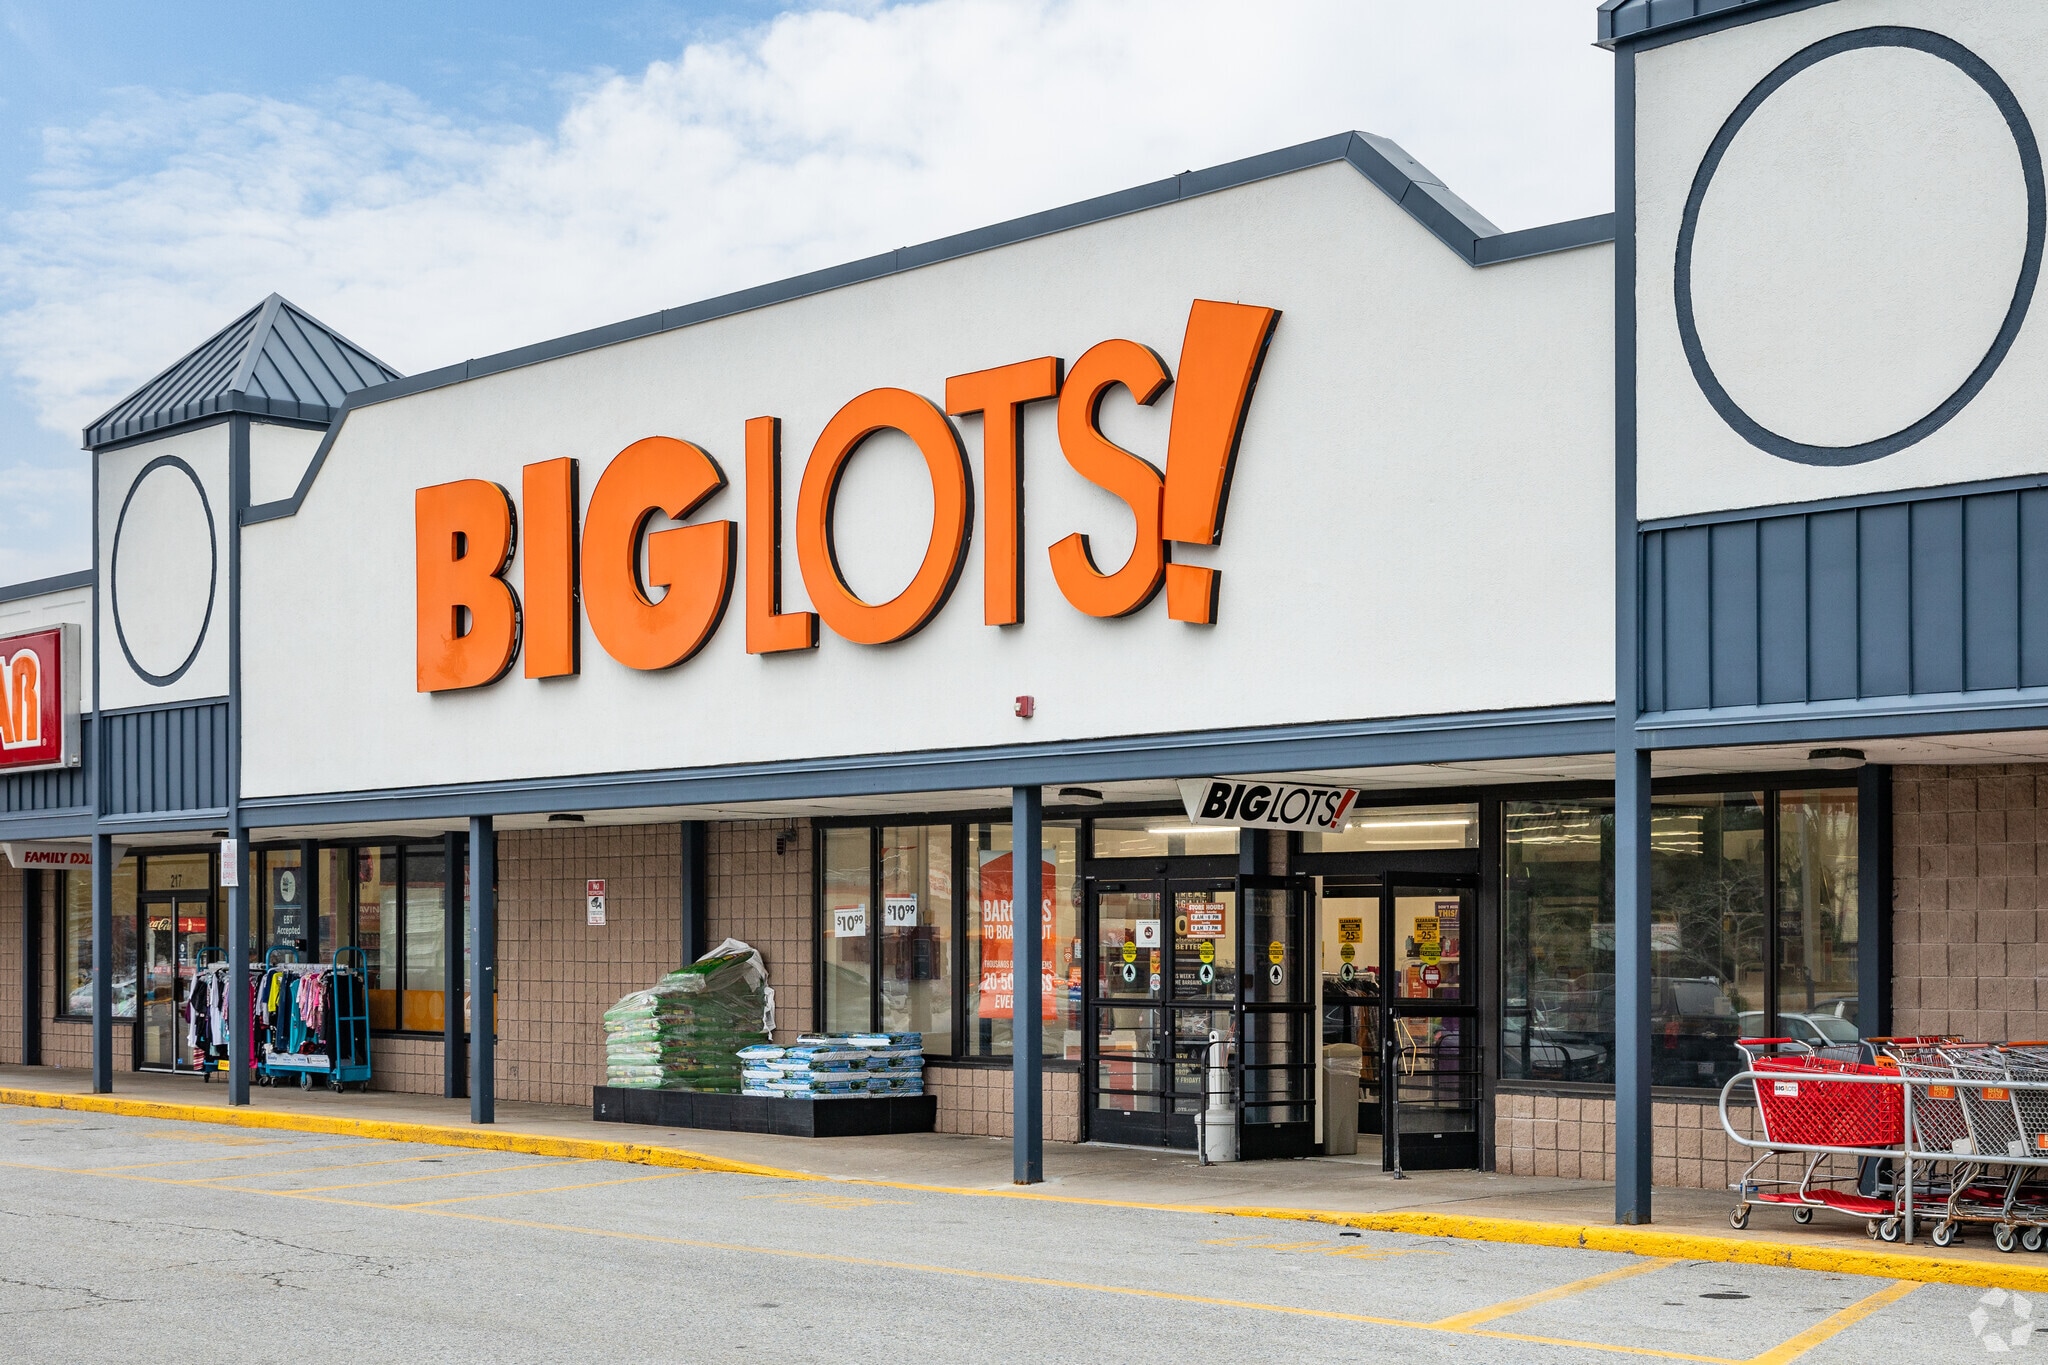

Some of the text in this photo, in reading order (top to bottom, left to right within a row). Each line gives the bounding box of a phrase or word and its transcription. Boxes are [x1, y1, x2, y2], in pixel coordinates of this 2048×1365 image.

[24, 851, 68, 864] FAMILY
[170, 874, 182, 888] 217
[283, 915, 293, 925] EBT
[276, 925, 301, 939] Accepted
[984, 924, 994, 940] TO
[1345, 931, 1355, 940] 25
[1421, 930, 1432, 940] 25
[282, 938, 295, 947] Here
[984, 960, 1009, 969] THOUSANDS
[983, 972, 1013, 991] 20-50
